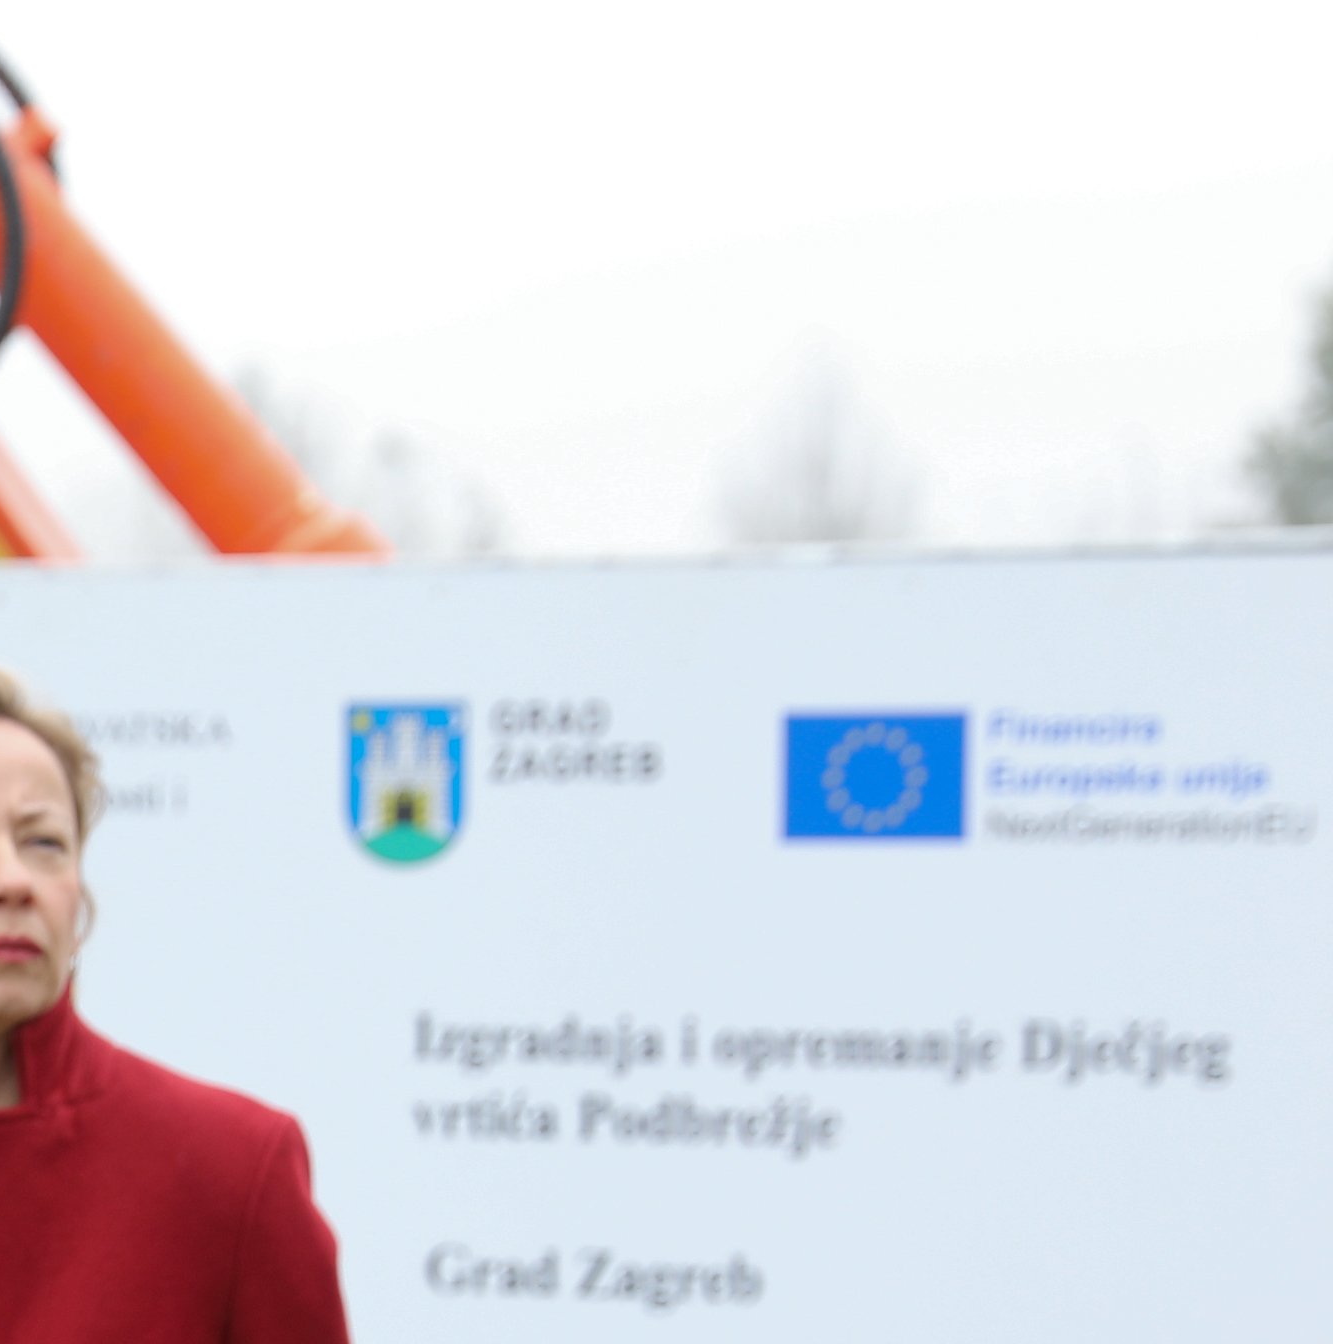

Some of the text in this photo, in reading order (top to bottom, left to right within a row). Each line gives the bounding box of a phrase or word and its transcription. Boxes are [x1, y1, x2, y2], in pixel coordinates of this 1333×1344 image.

[489, 699, 613, 736] GRAD
[489, 743, 664, 784] ZAGREB
[415, 1011, 665, 1079] Izgradnja
[680, 1014, 700, 1066] i
[713, 1019, 1004, 1084] opremanje
[424, 1241, 766, 1318] Grad Zagreb
